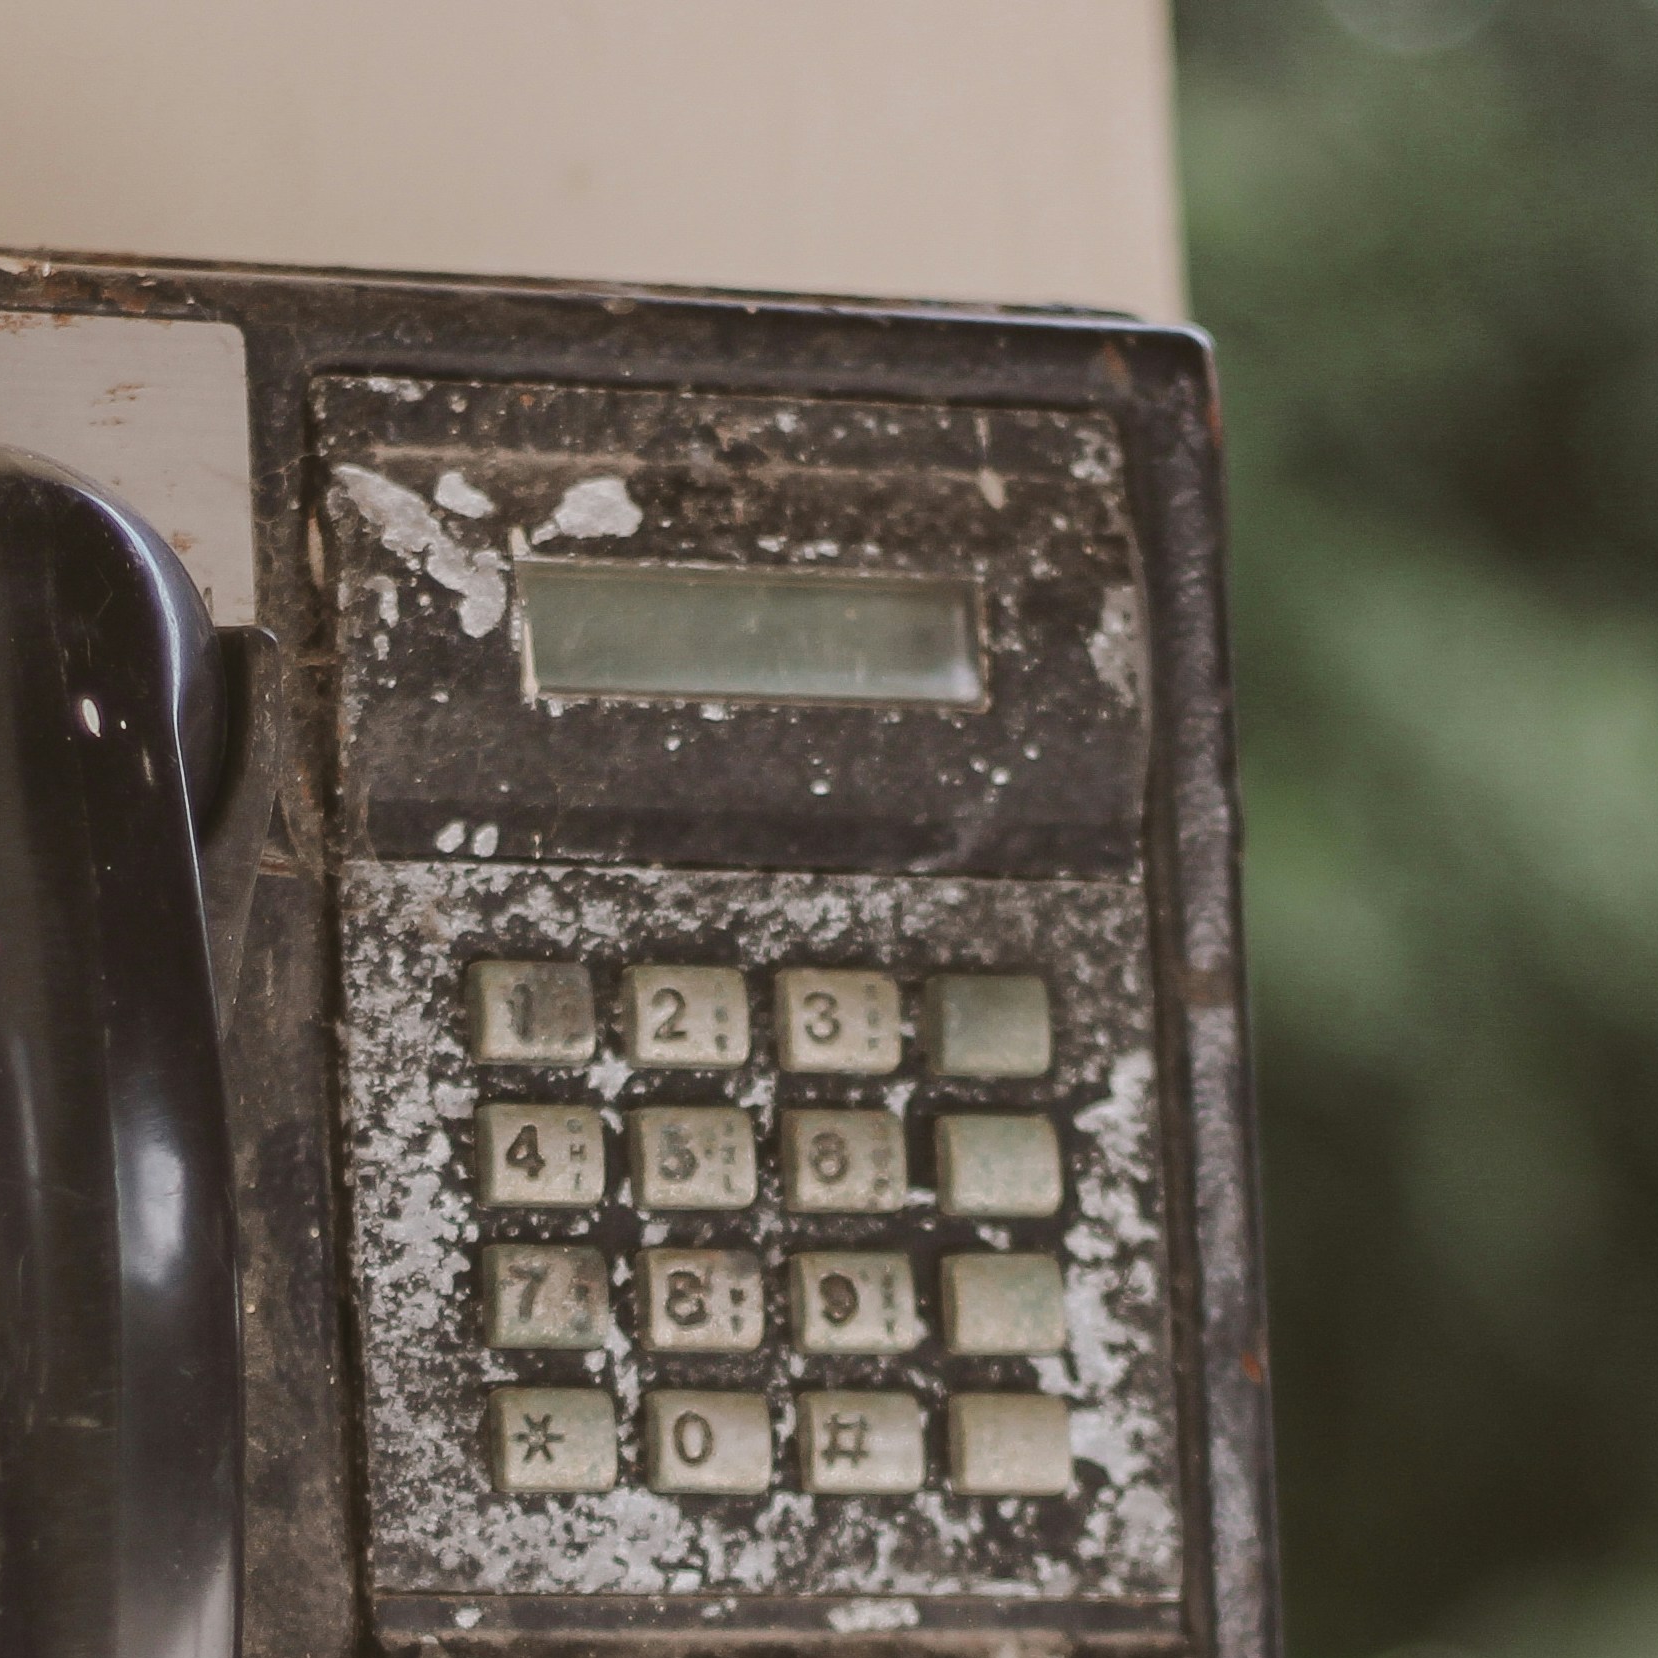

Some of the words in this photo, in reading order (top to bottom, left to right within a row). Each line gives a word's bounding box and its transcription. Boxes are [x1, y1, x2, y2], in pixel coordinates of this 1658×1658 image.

[651, 987, 688, 1041] 2
[803, 991, 841, 1045] 3
[506, 1124, 546, 1180] 4
[508, 1263, 548, 1323] 7
[673, 1410, 713, 1467] 0
